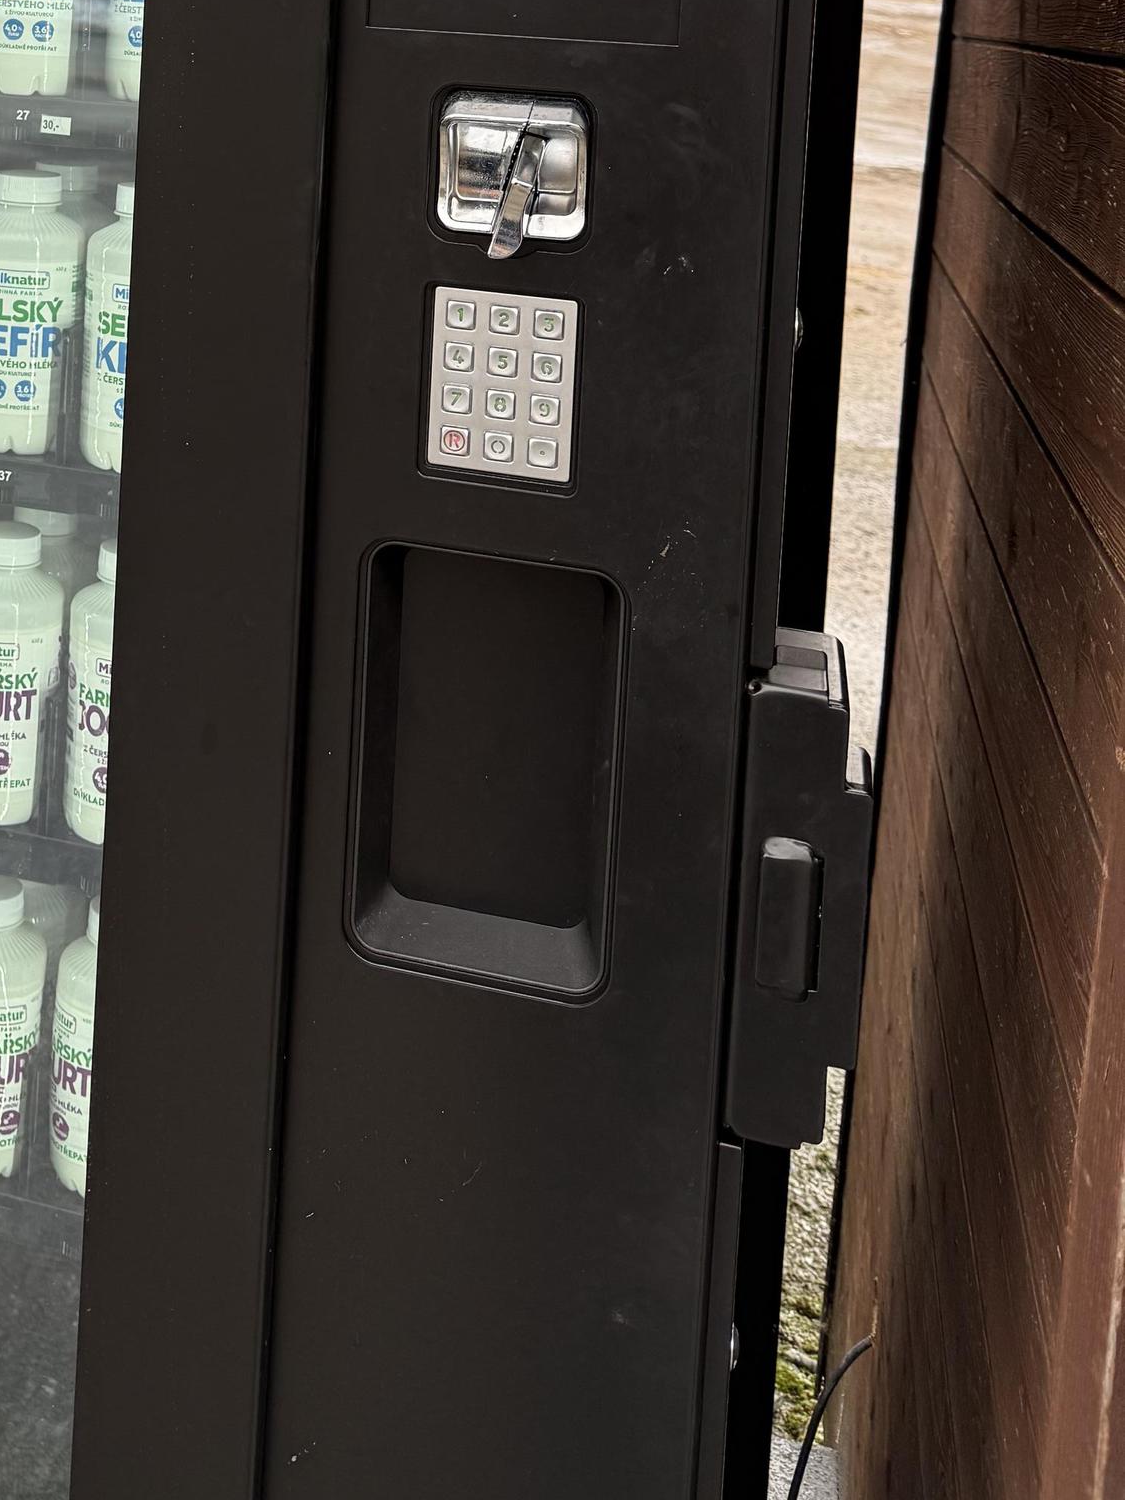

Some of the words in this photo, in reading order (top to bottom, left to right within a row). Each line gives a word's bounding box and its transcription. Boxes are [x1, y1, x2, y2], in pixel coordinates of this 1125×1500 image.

[16, 110, 30, 120] 27
[43, 119, 60, 131] 30,-
[457, 307, 465, 322] 1
[499, 313, 510, 328] 2
[544, 317, 555, 332] 3
[453, 349, 464, 364] 4
[498, 355, 508, 370] 5
[541, 361, 552, 376] 6
[451, 391, 461, 406] 7
[494, 396, 506, 412] 8
[539, 403, 550, 418] 9
